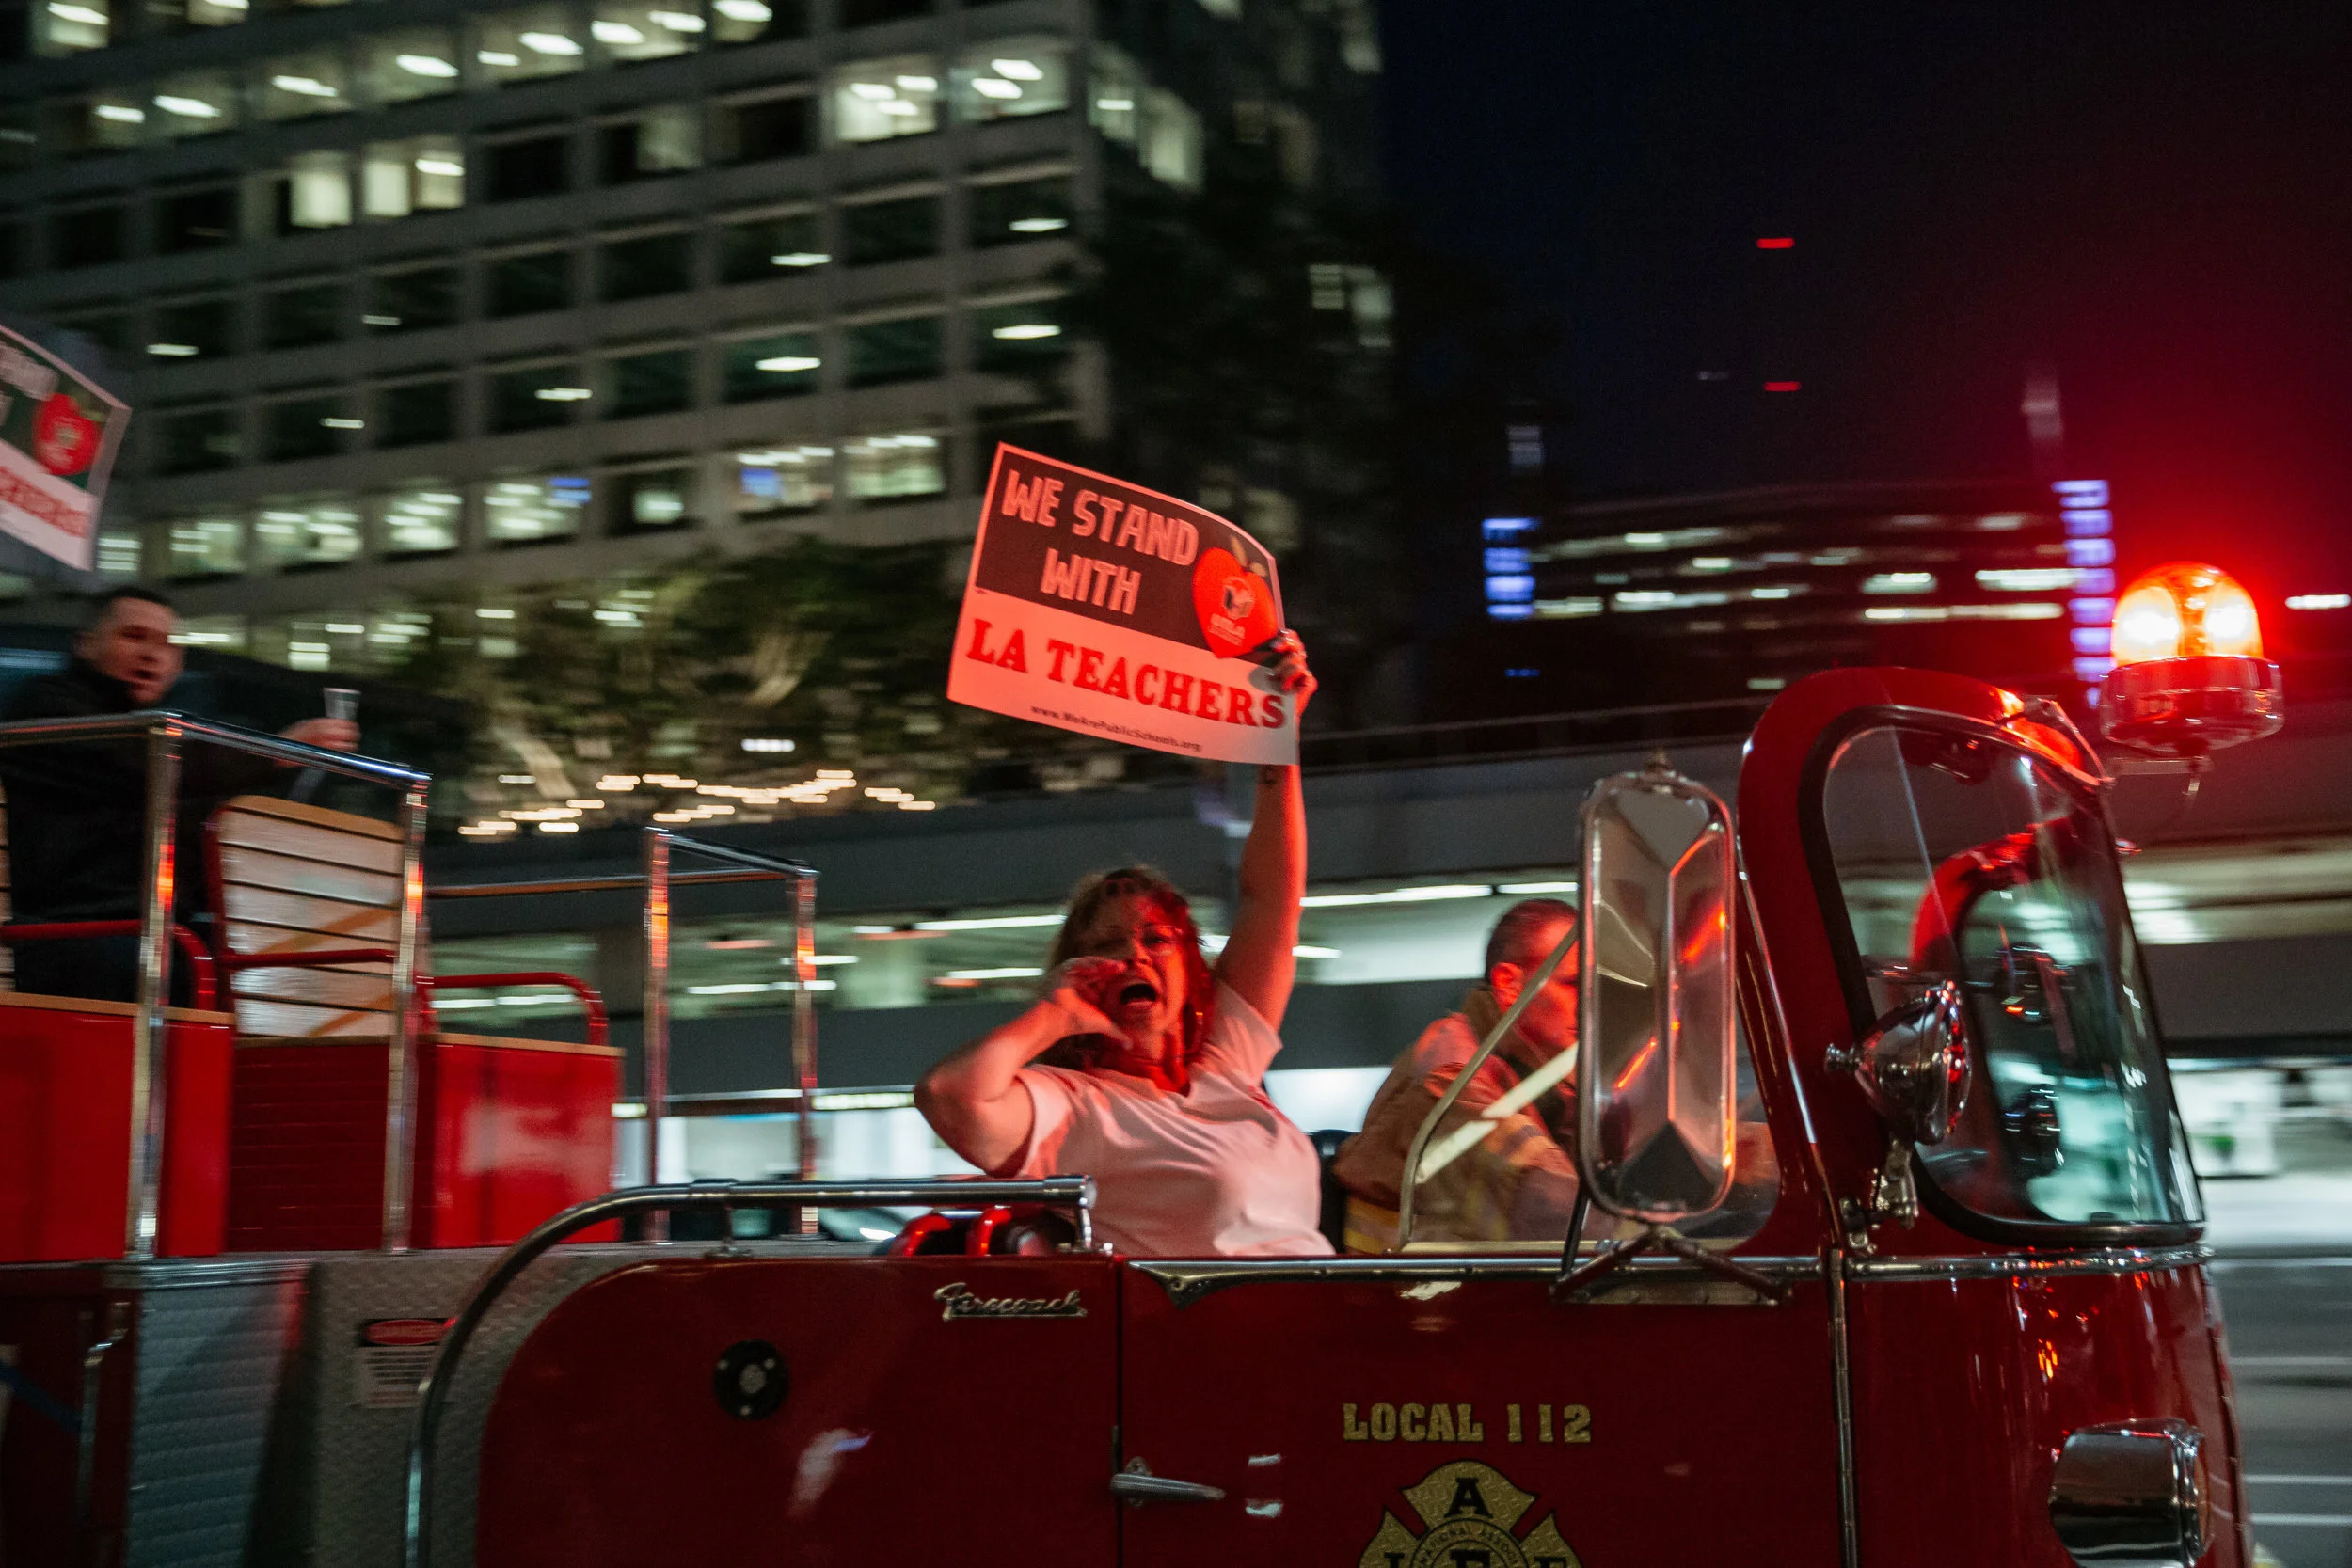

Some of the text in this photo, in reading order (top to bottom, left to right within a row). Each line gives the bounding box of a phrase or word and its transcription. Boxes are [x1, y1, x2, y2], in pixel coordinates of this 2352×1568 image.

[1001, 470, 1200, 566] WE STAND
[1041, 548, 1142, 615] WITH
[966, 618, 1287, 729] LA TEACHERS
[1343, 1402, 1592, 1443] LOCAL 112
[1444, 1477, 1493, 1518] A
